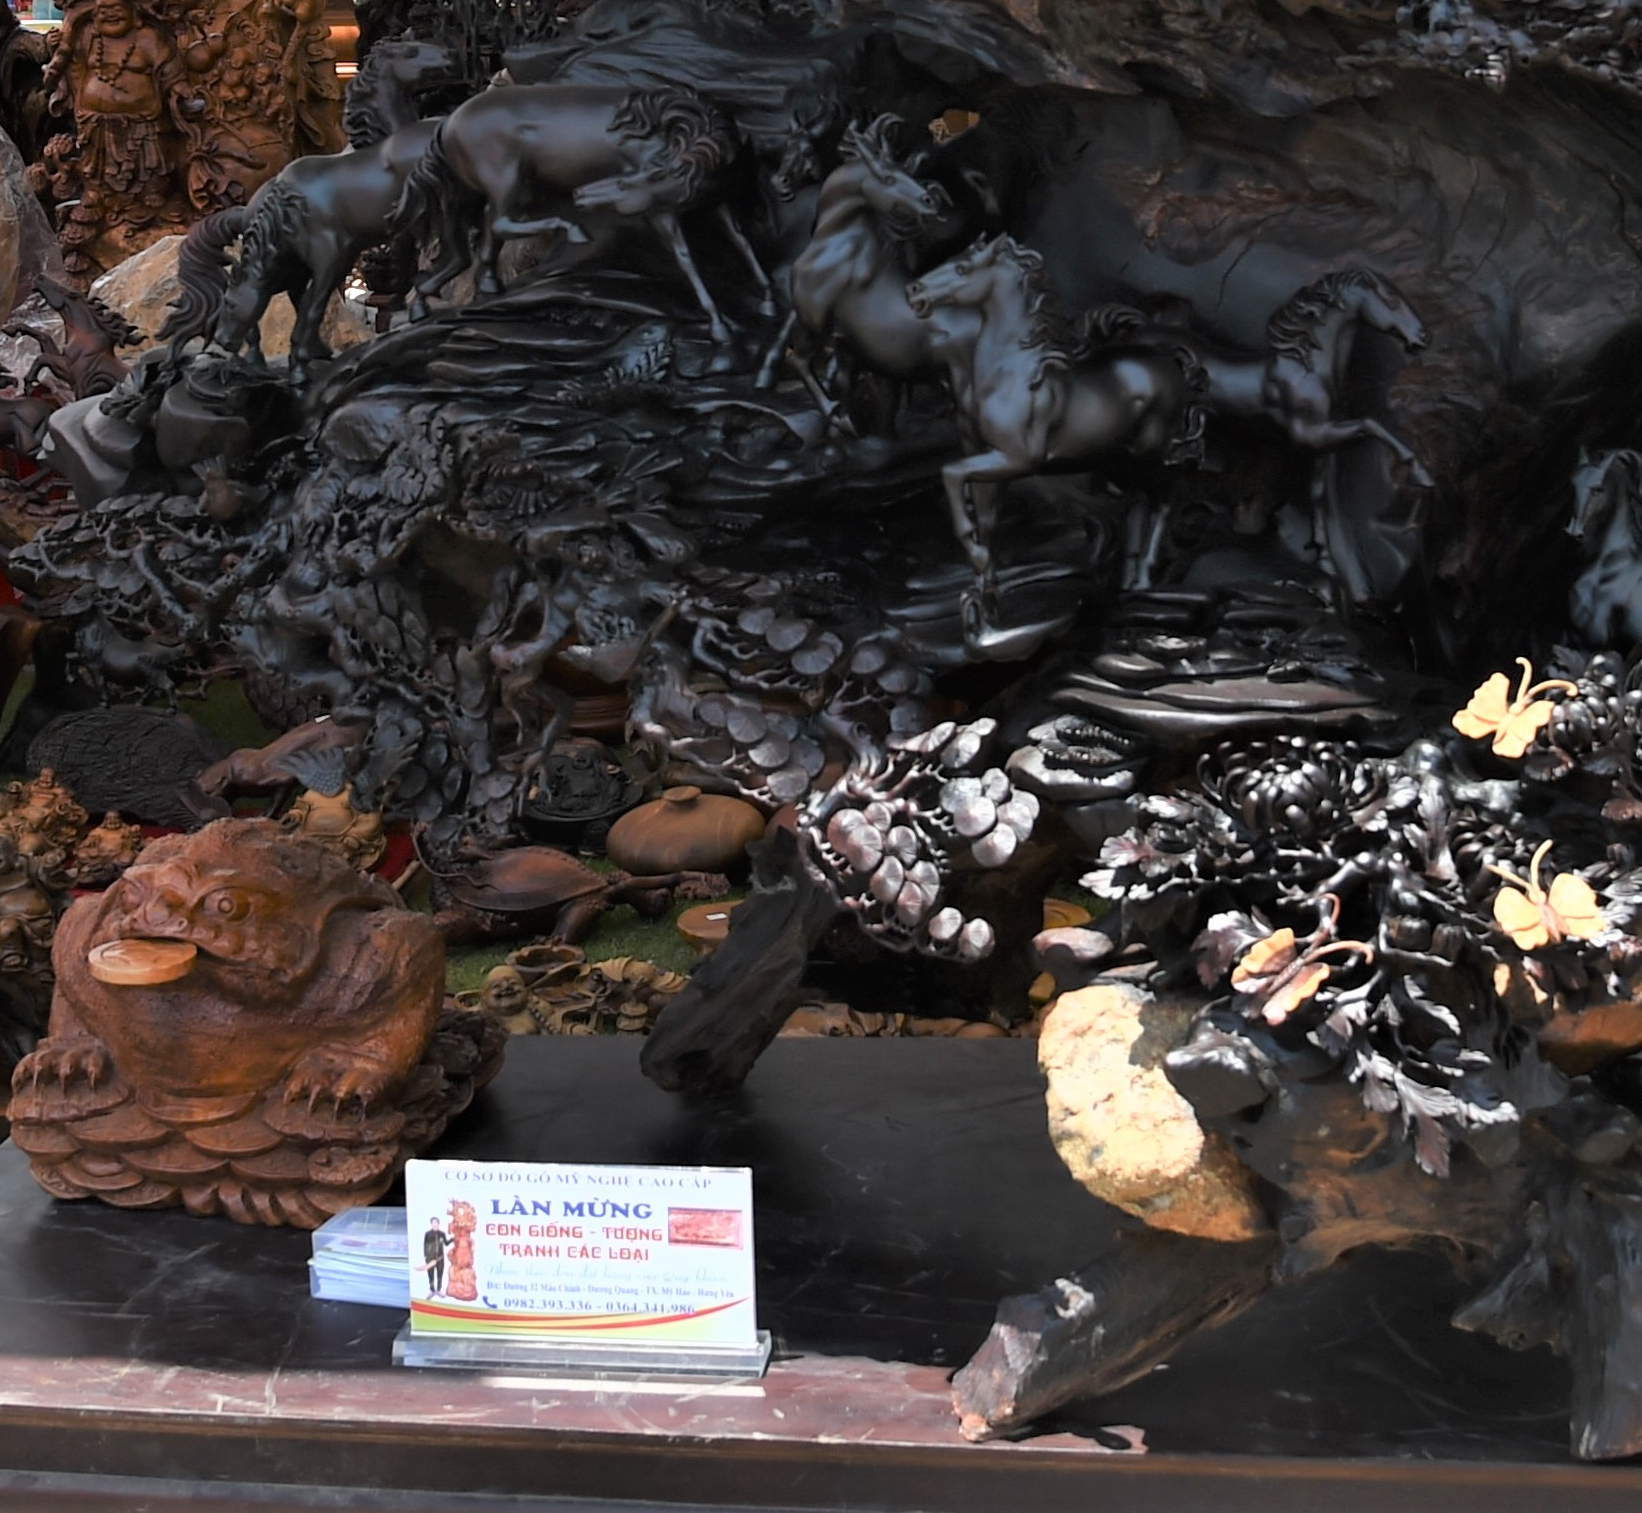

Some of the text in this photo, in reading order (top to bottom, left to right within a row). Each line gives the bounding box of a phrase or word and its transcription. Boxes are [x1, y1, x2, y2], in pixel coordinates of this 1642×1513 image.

[445, 1170, 468, 1182] CƠ
[472, 1168, 494, 1182] SỞ
[556, 1171, 581, 1185] MỸ
[586, 1174, 632, 1188] NGHỆ
[638, 1175, 674, 1187] CAO
[678, 1175, 712, 1189] CẤP
[491, 1195, 653, 1219] LÀN MỪNG
[485, 1223, 521, 1236] CON
[528, 1220, 583, 1239] GIỐNG
[602, 1225, 663, 1243] TƯỢNG
[499, 1243, 649, 1263] TRANH CÁC LOẠI
[504, 1297, 592, 1311] 0982.393.336
